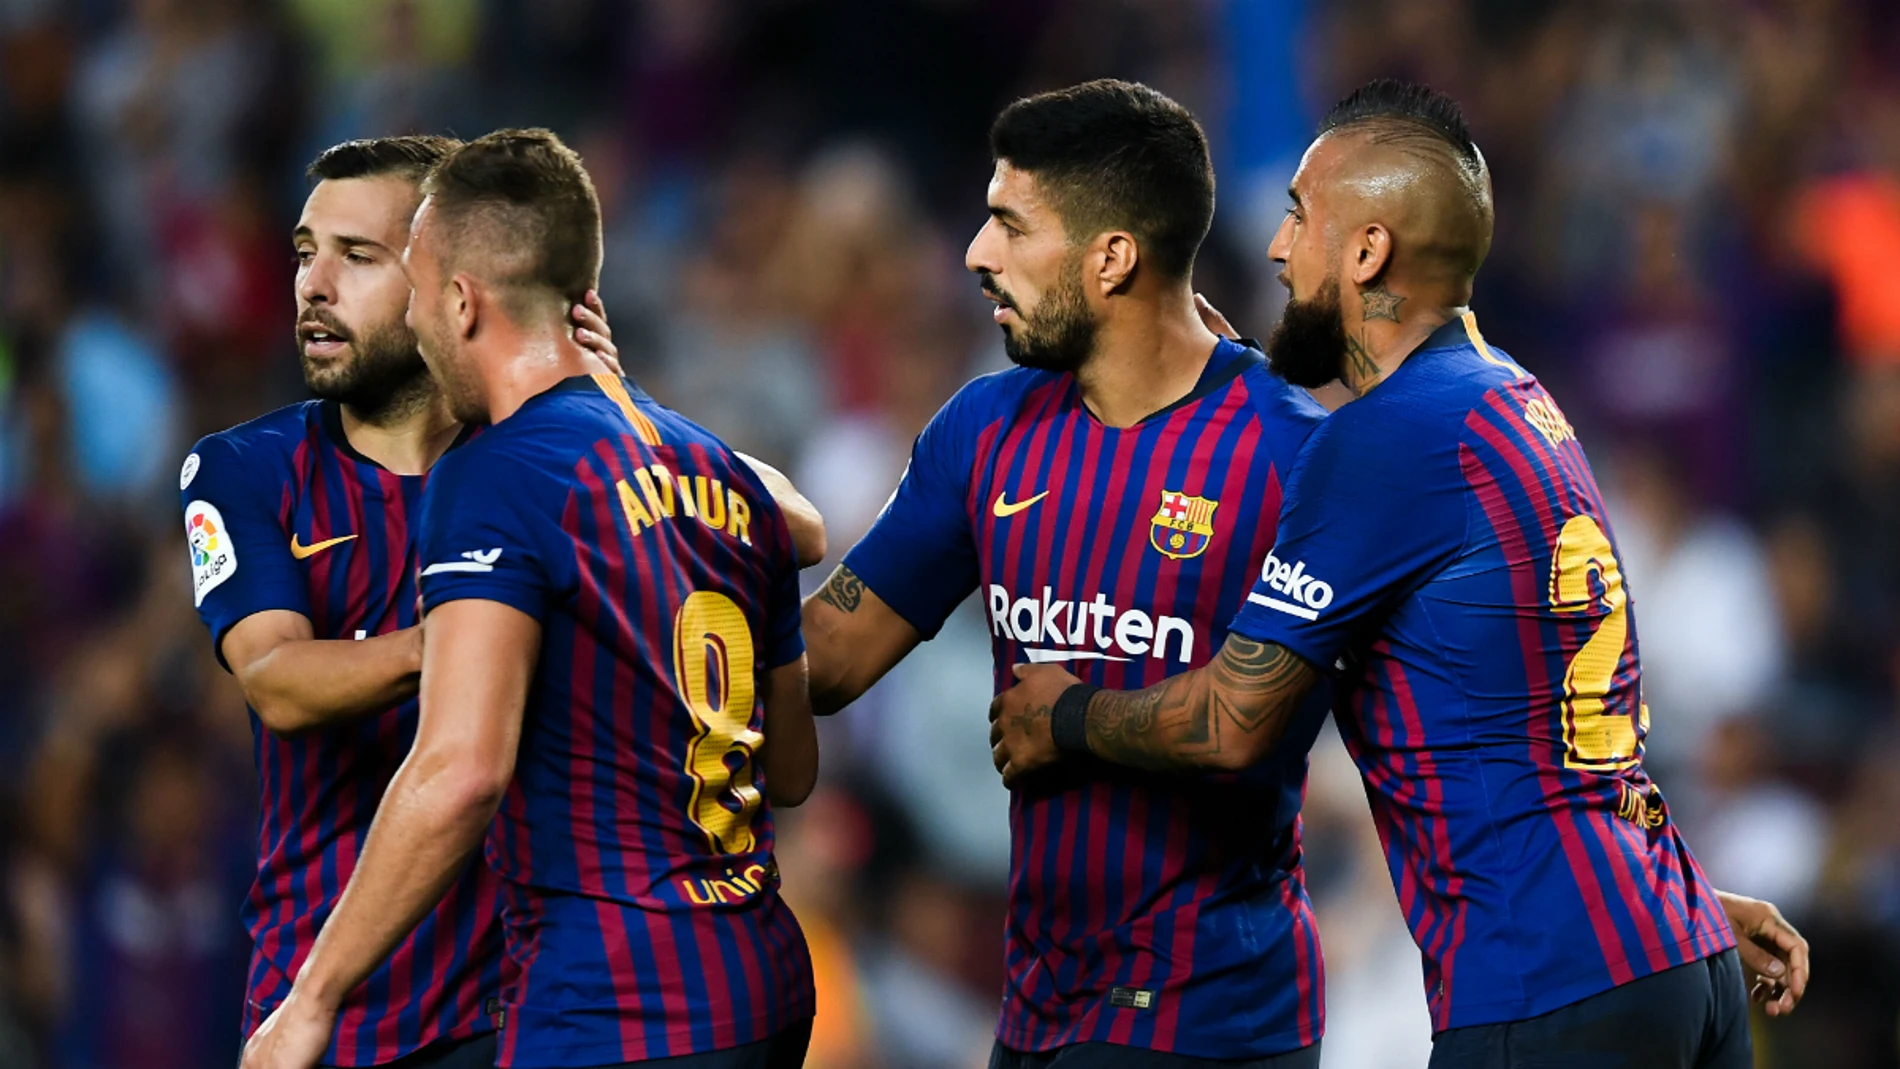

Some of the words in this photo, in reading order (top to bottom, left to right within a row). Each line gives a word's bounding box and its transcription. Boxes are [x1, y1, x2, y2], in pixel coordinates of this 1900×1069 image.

[1170, 519, 1194, 531] FCB
[1261, 548, 1334, 609] beko
[989, 584, 1195, 663] Rakuten
[673, 590, 765, 855] 8
